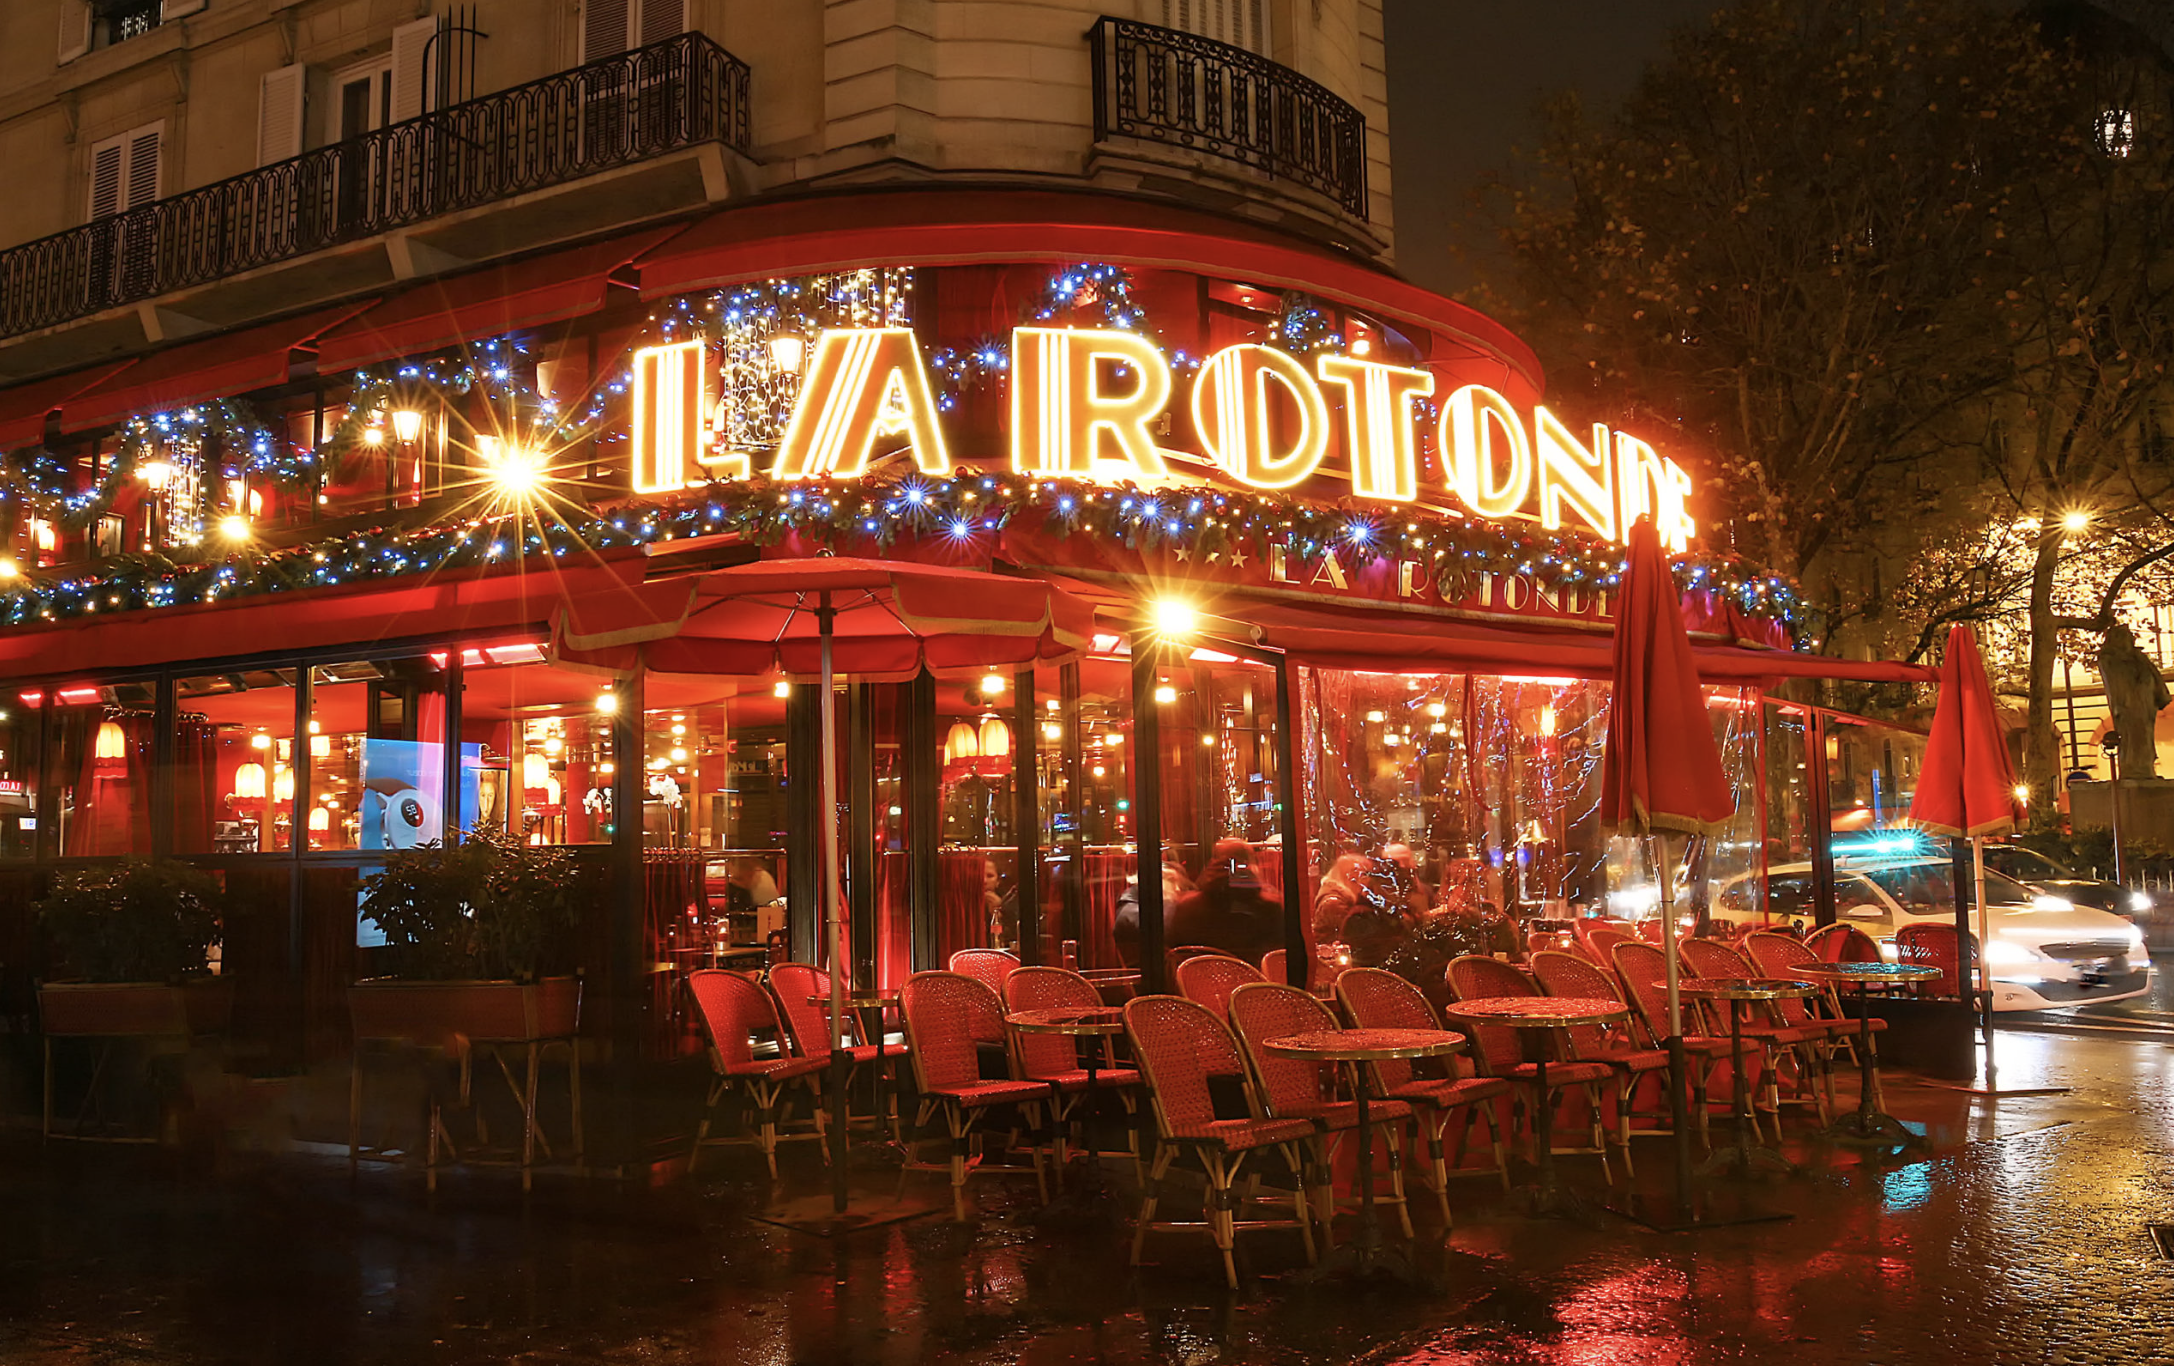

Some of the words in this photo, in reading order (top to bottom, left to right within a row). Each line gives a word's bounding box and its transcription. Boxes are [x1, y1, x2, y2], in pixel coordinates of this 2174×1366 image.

[632, 328, 950, 494] LA
[1011, 326, 1696, 553] ROTONDE
[1269, 542, 1349, 590] LA
